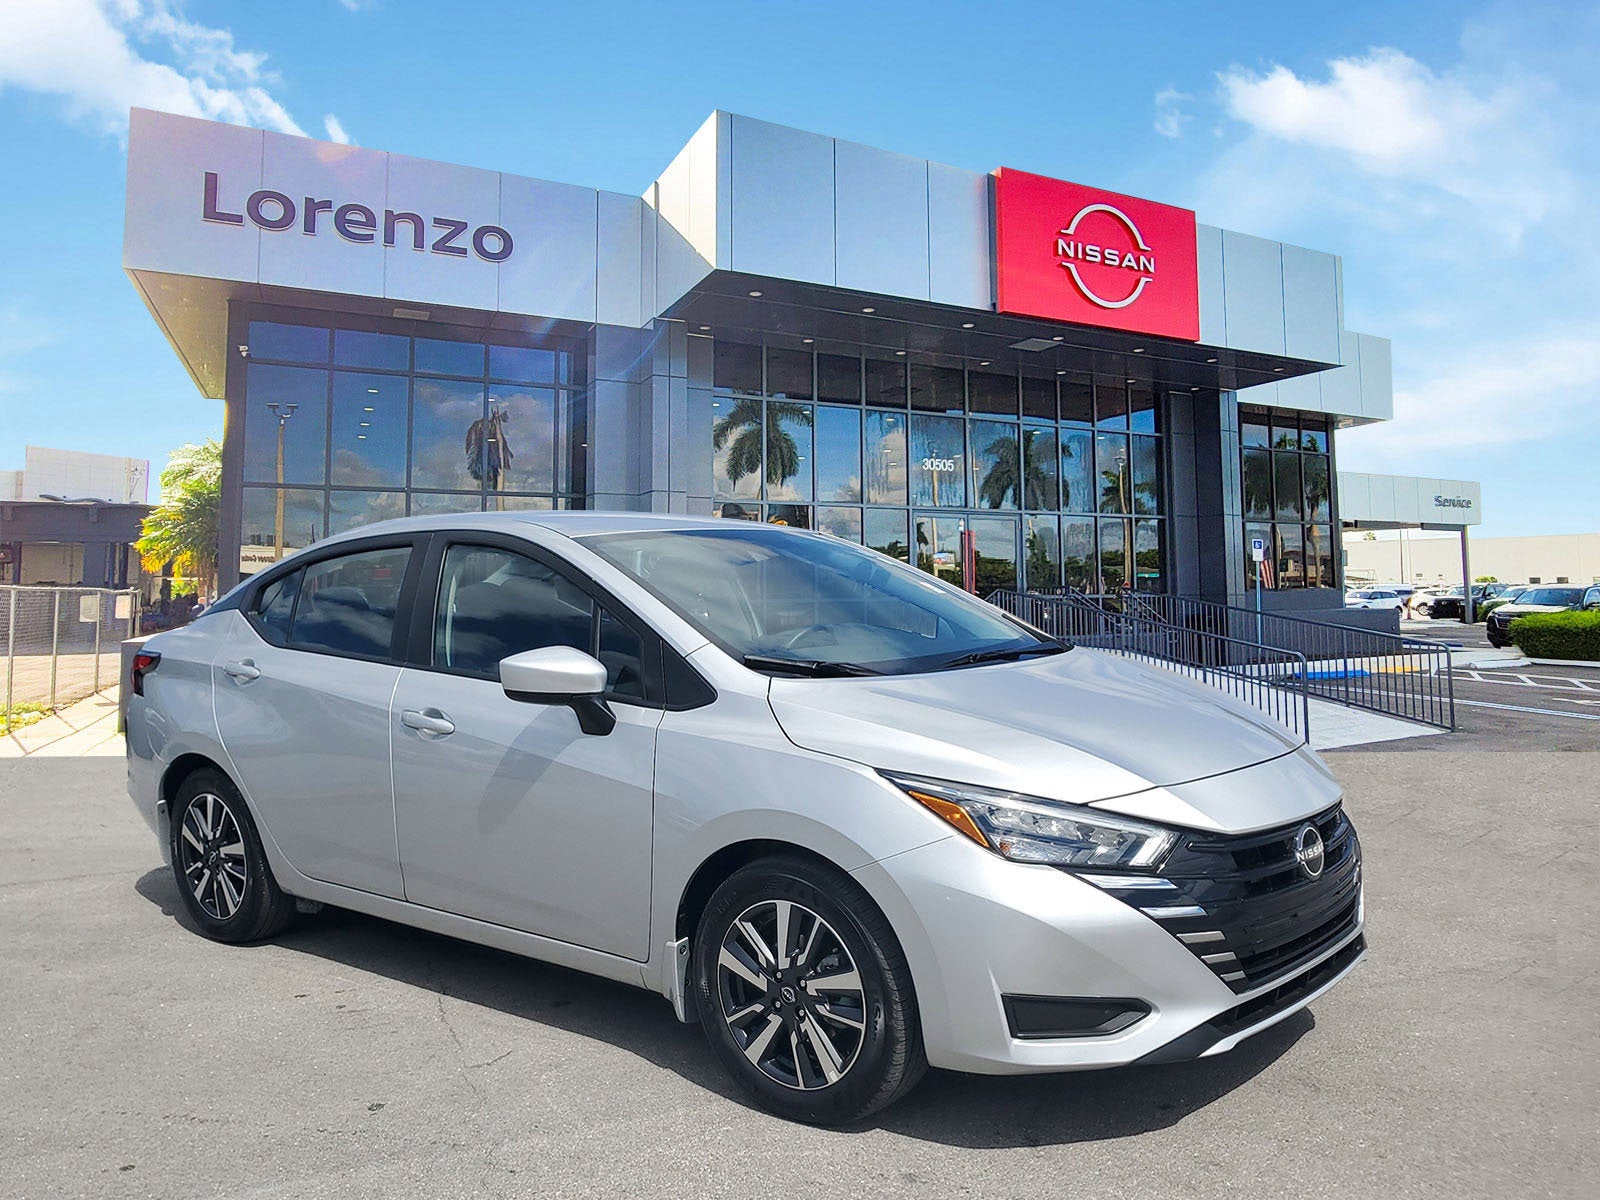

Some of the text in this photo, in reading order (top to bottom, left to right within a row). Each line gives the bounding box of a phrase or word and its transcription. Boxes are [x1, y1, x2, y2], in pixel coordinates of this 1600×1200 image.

[203, 171, 514, 262] Lorenzo
[1057, 238, 1155, 273] NISSAN
[922, 458, 954, 471] 30505
[1434, 495, 1472, 508] Service
